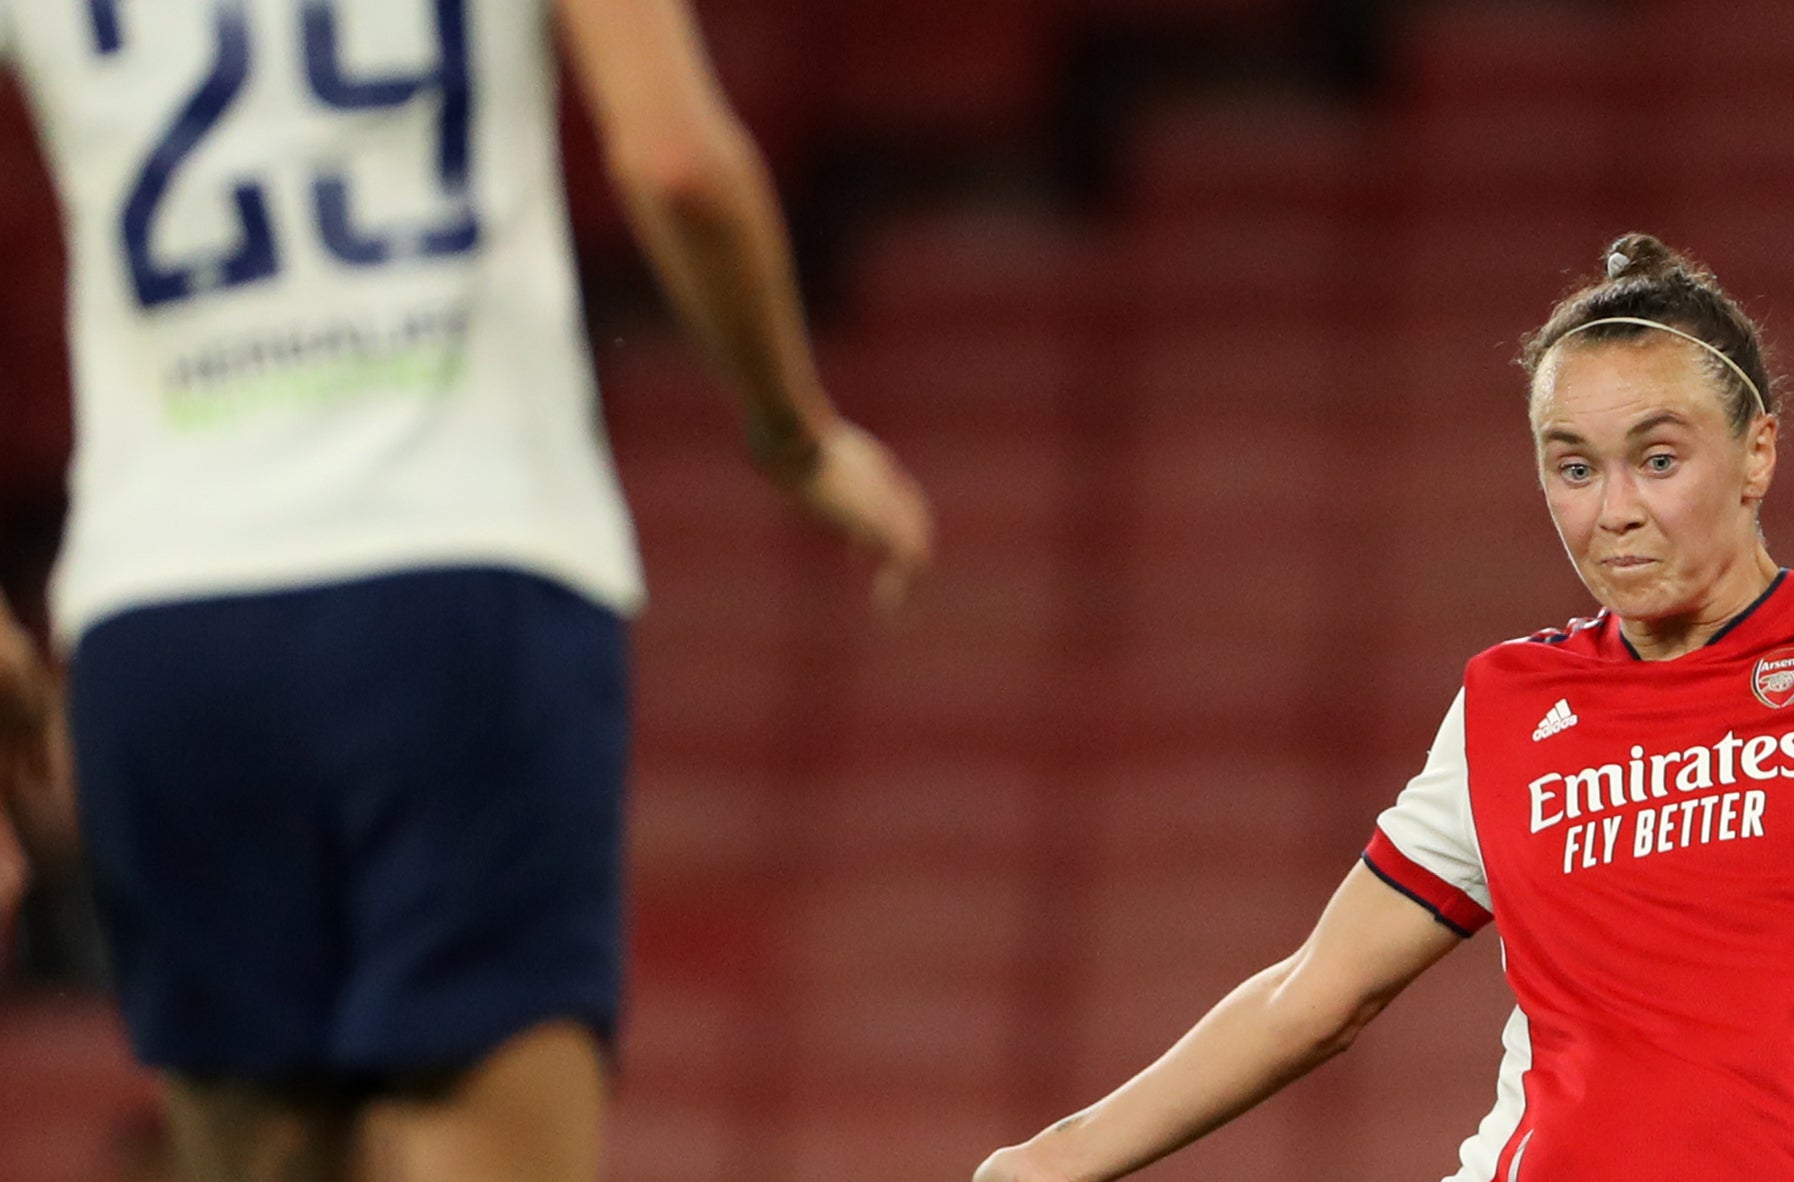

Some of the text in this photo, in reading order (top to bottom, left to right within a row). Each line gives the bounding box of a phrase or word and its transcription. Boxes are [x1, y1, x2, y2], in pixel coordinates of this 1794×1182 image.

[89, 0, 480, 307] 29
[1532, 714, 1578, 742] adidas
[1563, 790, 1766, 874] FLY BETTER
